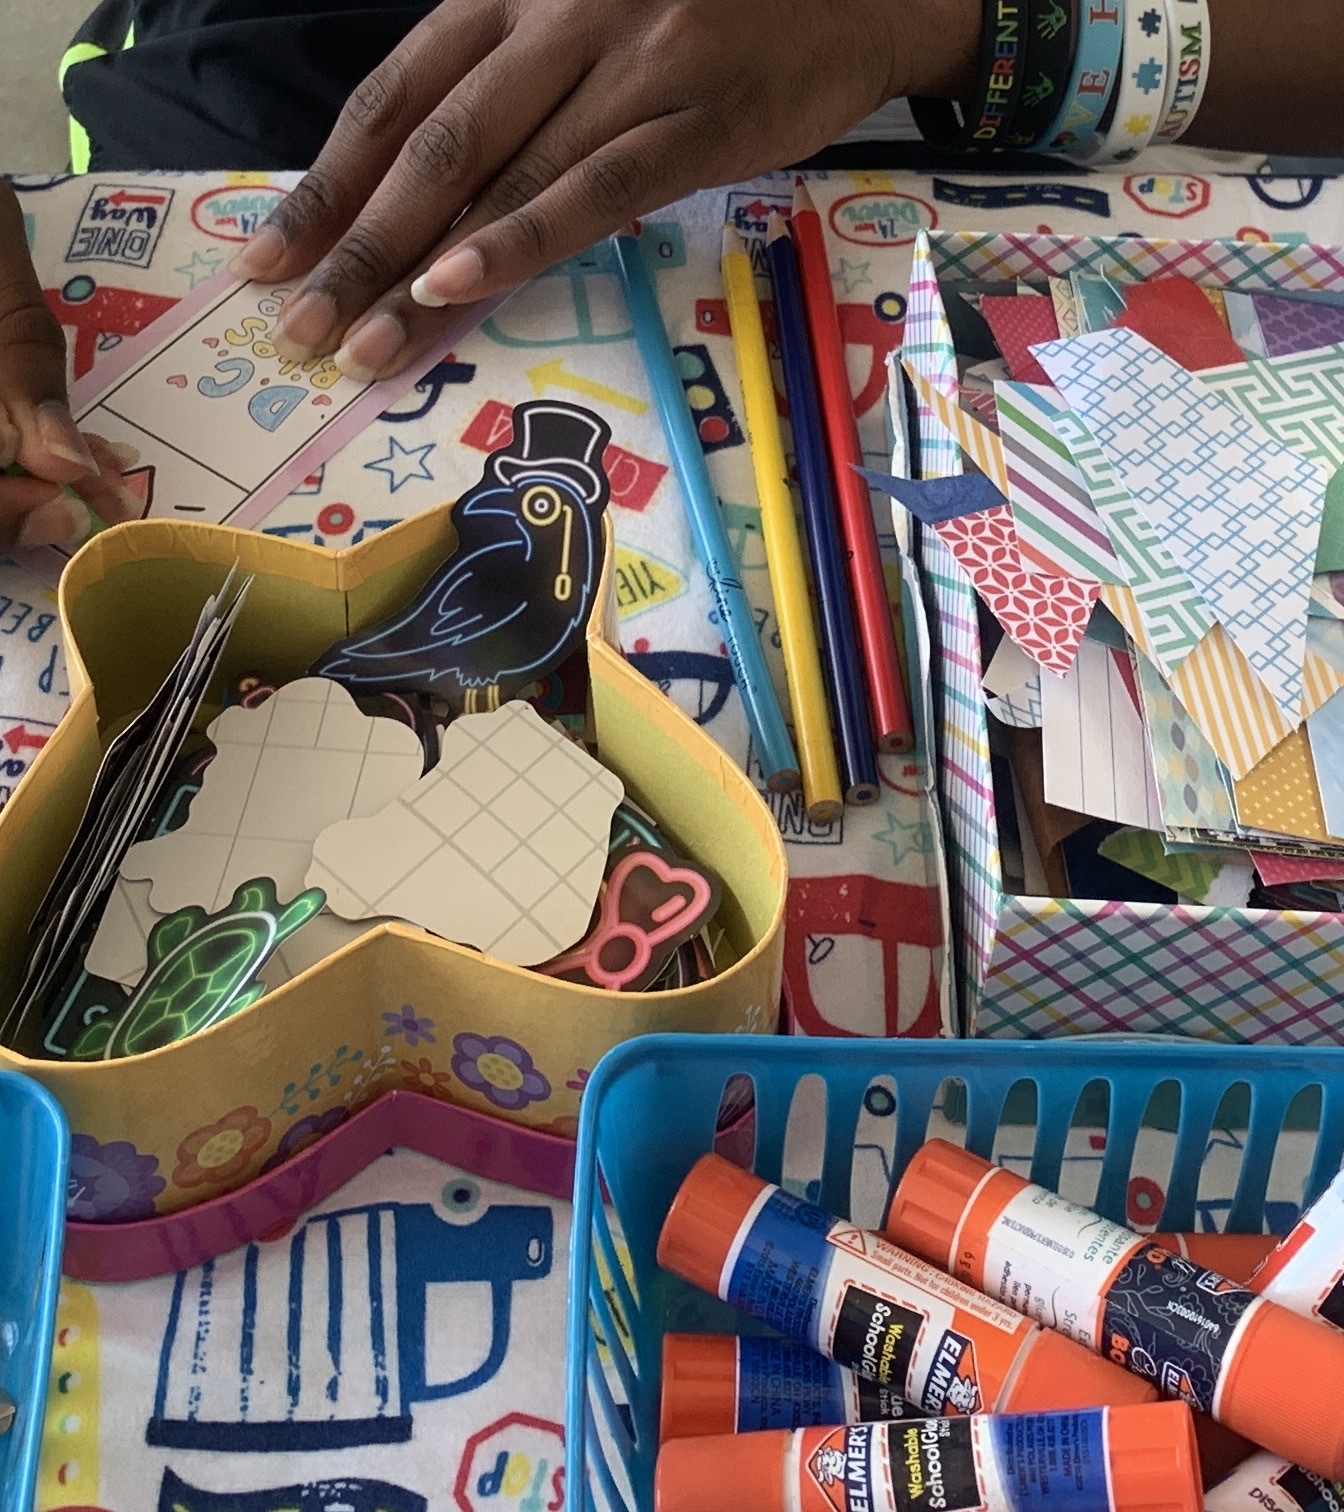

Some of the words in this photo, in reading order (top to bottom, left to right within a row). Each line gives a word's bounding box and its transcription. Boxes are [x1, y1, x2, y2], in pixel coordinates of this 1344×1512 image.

[973, 0, 1019, 140] DIFFERENT
[1156, 21, 1204, 140] AUTISM
[71, 226, 151, 262] ONE
[90, 197, 158, 229] Way
[902, 1426, 925, 1501] Washable
